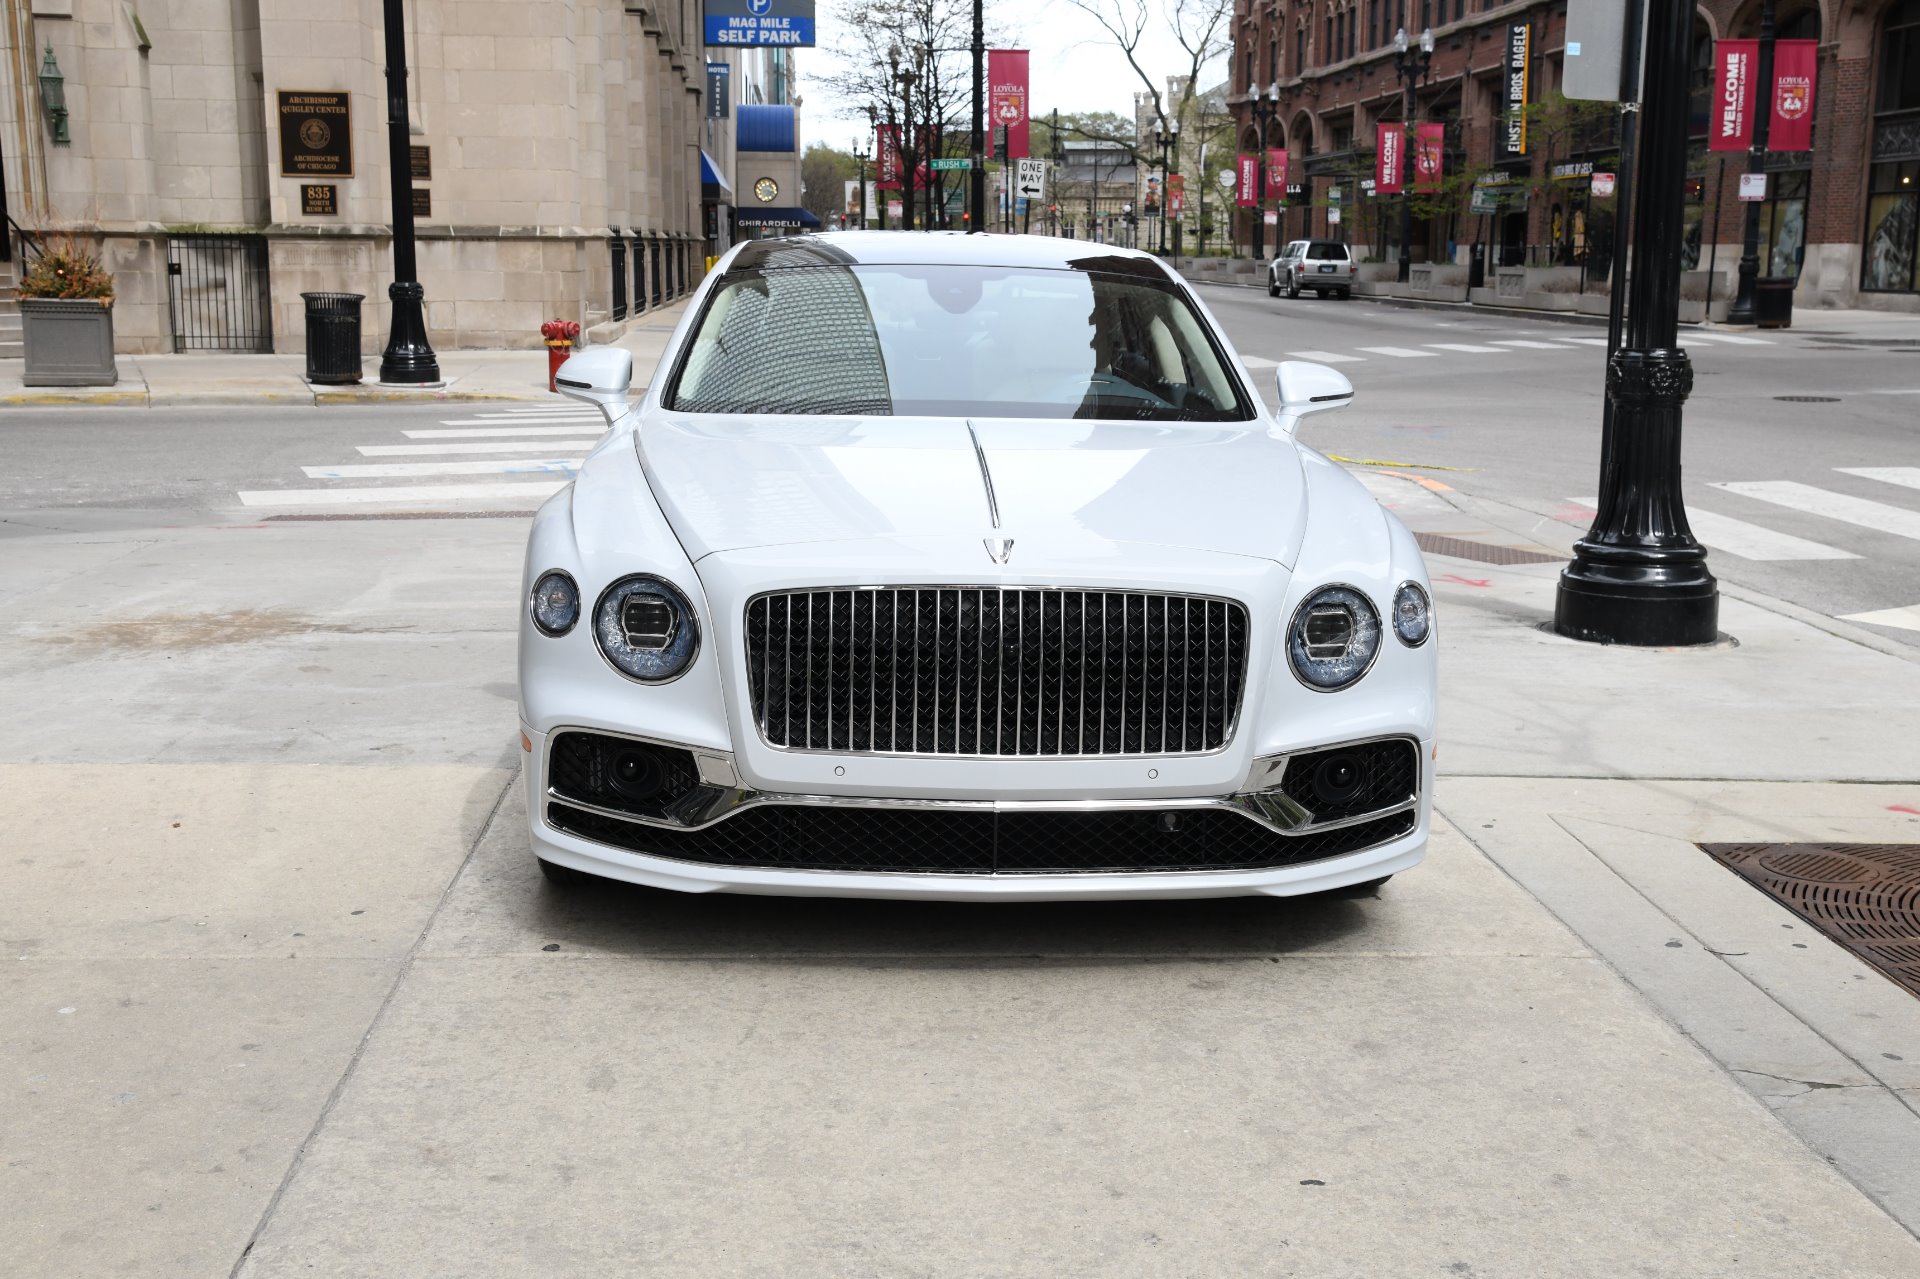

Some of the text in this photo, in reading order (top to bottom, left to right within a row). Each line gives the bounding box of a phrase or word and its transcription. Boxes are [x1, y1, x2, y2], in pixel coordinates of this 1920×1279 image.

[729, 17, 790, 28] MAG MILE
[718, 29, 801, 43] SELF PARK
[1512, 26, 1527, 68] BAGELS
[1779, 76, 1810, 84] LOYOLA
[993, 84, 1024, 92] LOYOLA
[289, 96, 338, 104] ARCHBISHOP
[1722, 53, 1739, 137] WELCOME
[1735, 53, 1747, 137] WATER TOWER CAMPUS
[281, 105, 315, 113] QUIGLEY
[1382, 131, 1393, 184] WELCOME
[938, 160, 960, 169] RUSH
[1021, 162, 1042, 173] ONE
[1020, 173, 1042, 184] WAY
[1242, 160, 1250, 200] WELCOME
[307, 186, 330, 199] 835
